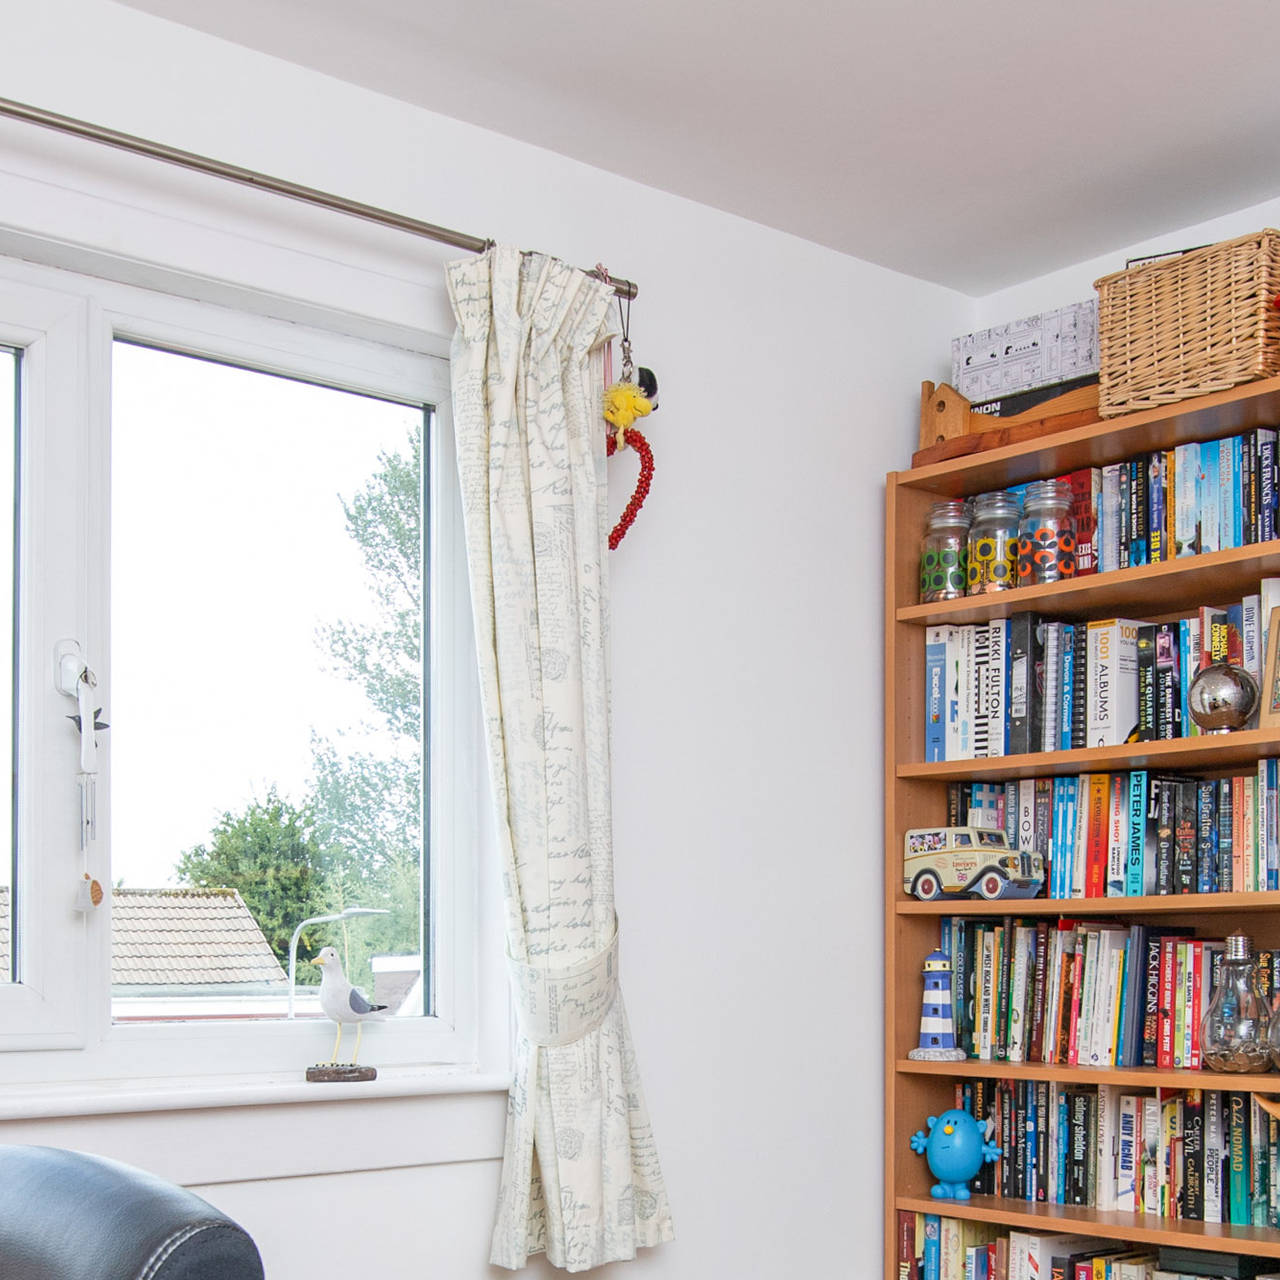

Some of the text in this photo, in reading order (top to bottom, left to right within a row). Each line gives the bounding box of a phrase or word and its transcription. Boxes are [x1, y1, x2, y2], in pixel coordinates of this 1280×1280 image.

[1262, 444, 1273, 504] DICK FRANCIS
[1150, 530, 1160, 549] DEE
[1211, 623, 1228, 661] MICHAEL CONNELLY
[1244, 606, 1256, 663] DAVE GORMAN
[990, 626, 1002, 719] RIKKI FULTON
[1062, 655, 1071, 732] Devon & Cornwall
[1098, 630, 1109, 721] 1001 ALBUMS
[1145, 665, 1154, 729] THE QUARRY
[1164, 671, 1173, 716] THE DARKEST
[1139, 693, 1147, 730] THEORIN
[1113, 777, 1121, 843] PARTING SHOT
[1130, 774, 1142, 867] PETER JAMES
[1201, 785, 1212, 838] Sue Grafton
[1159, 859, 1170, 886] Outlaw
[982, 953, 992, 1015] WEST HIGHLAND WHITE
[1147, 942, 1160, 1013] JACK HIGGINS
[1015, 1109, 1027, 1170] Freddie Mercury
[1073, 1096, 1087, 1160] sidney sheldon
[1120, 1113, 1134, 1171] ANDY McNAB
[1184, 1129, 1195, 1156] EVIL
[1206, 1093, 1217, 1185] PETER MAY PEOPLE
[1233, 1127, 1243, 1172] NOMAD
[1187, 1158, 1195, 1209] GALBRAITH
